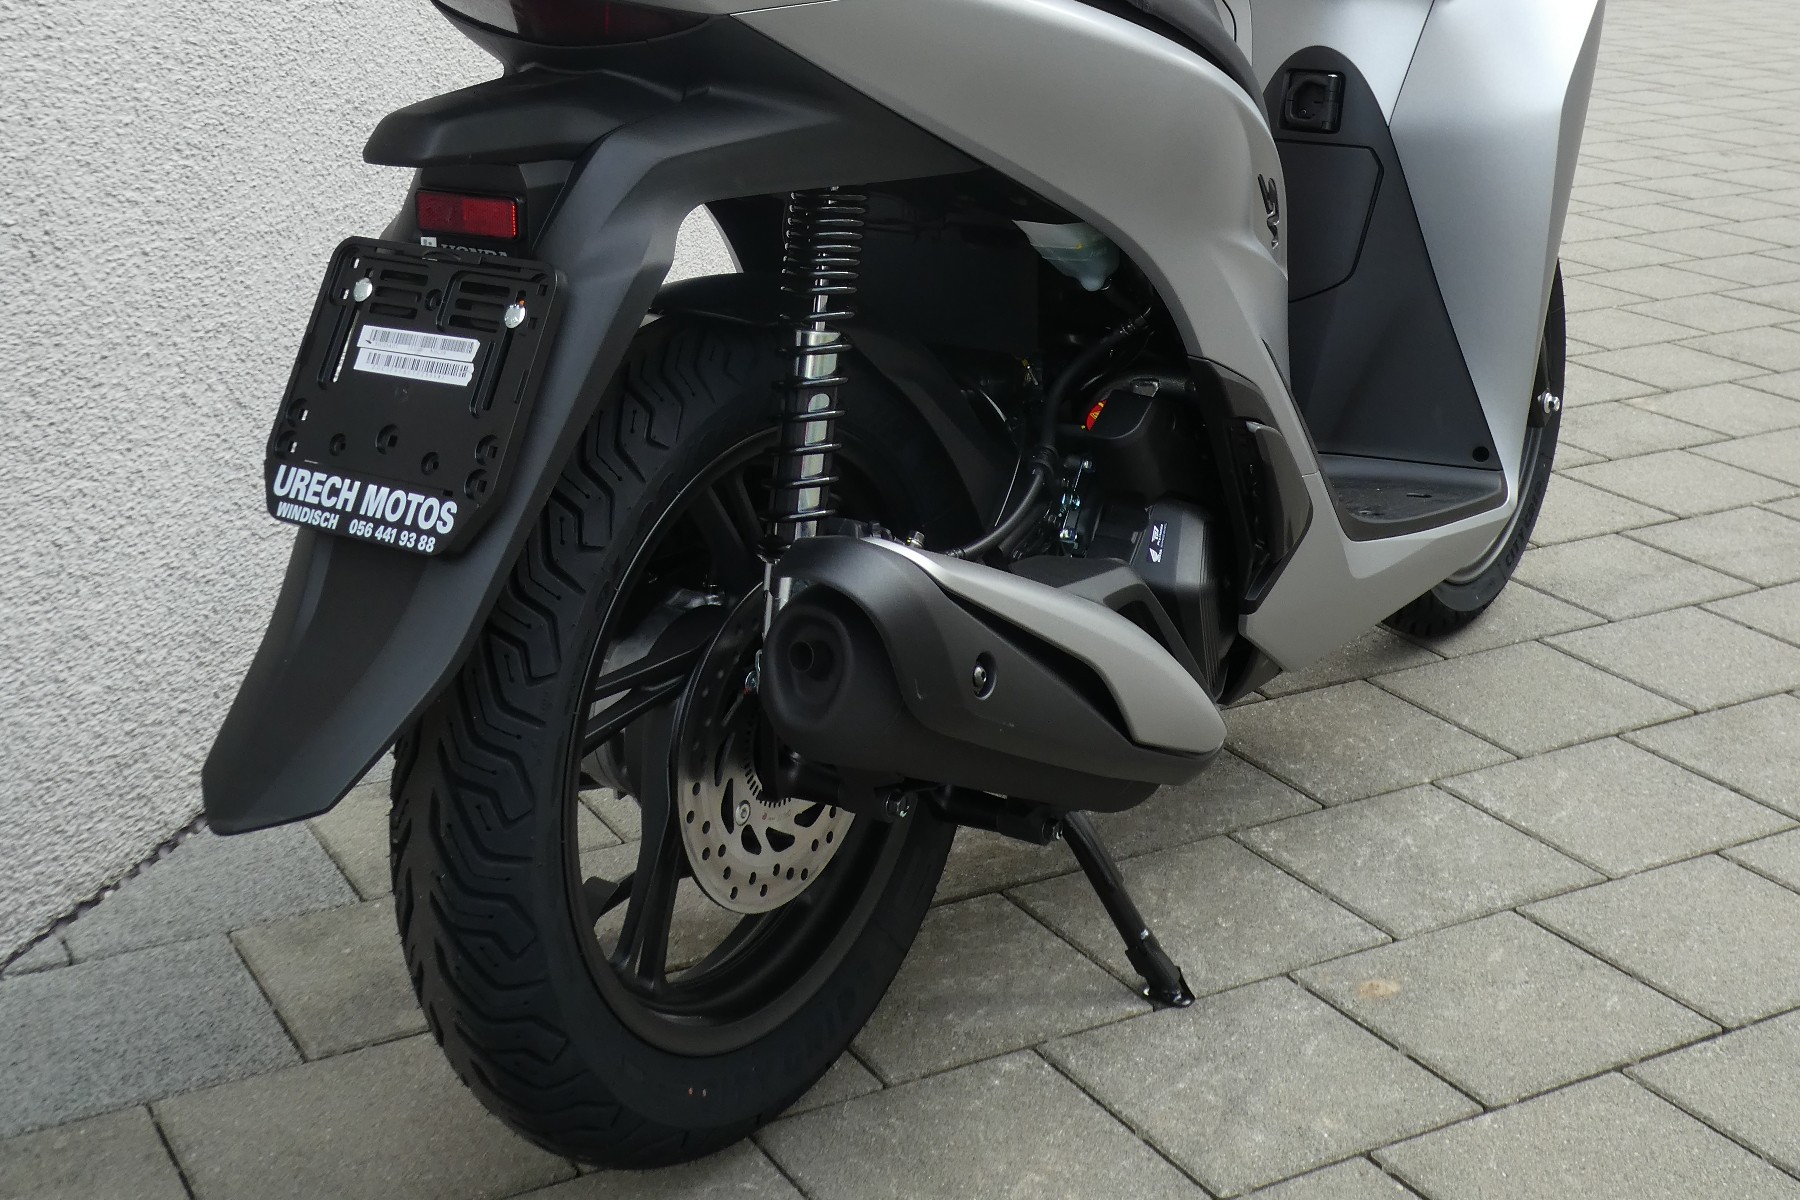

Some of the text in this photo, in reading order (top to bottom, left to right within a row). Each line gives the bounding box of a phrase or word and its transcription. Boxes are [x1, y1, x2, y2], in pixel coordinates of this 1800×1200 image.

[273, 464, 458, 535] URECH MOTOS
[276, 501, 436, 553] WINDISCH 056 441 93 88
